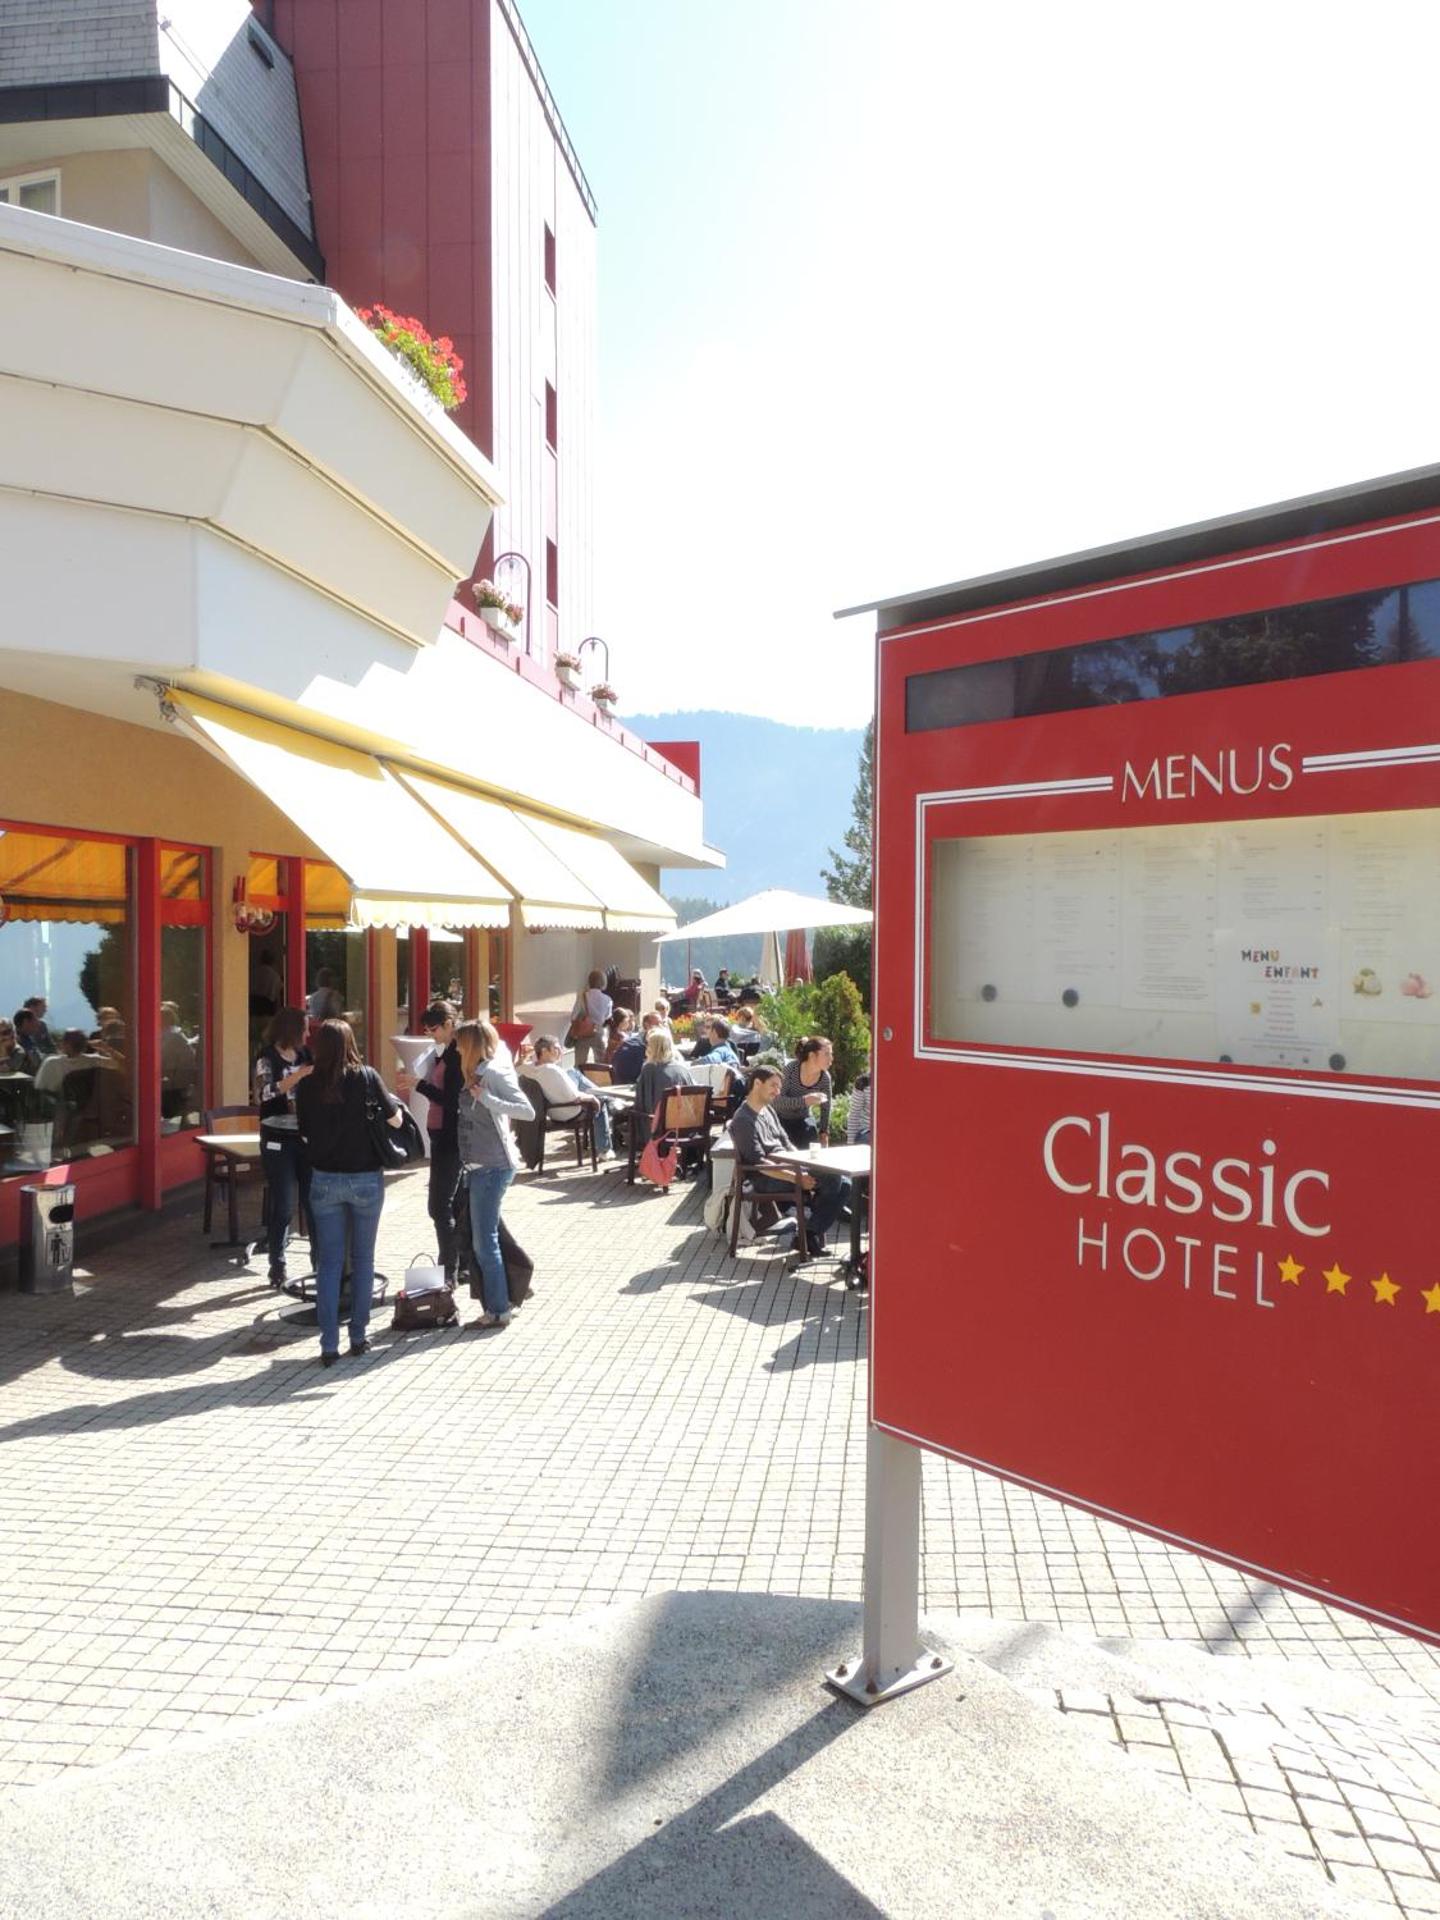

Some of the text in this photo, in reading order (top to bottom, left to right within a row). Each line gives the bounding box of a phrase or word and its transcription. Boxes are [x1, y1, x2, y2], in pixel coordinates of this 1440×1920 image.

[1121, 743, 1294, 803] MENUS
[1241, 949, 1279, 963] MENU
[1265, 965, 1319, 979] ENFANT
[1043, 1111, 1331, 1238] Classic
[1078, 1217, 1275, 1308] HOTEL
